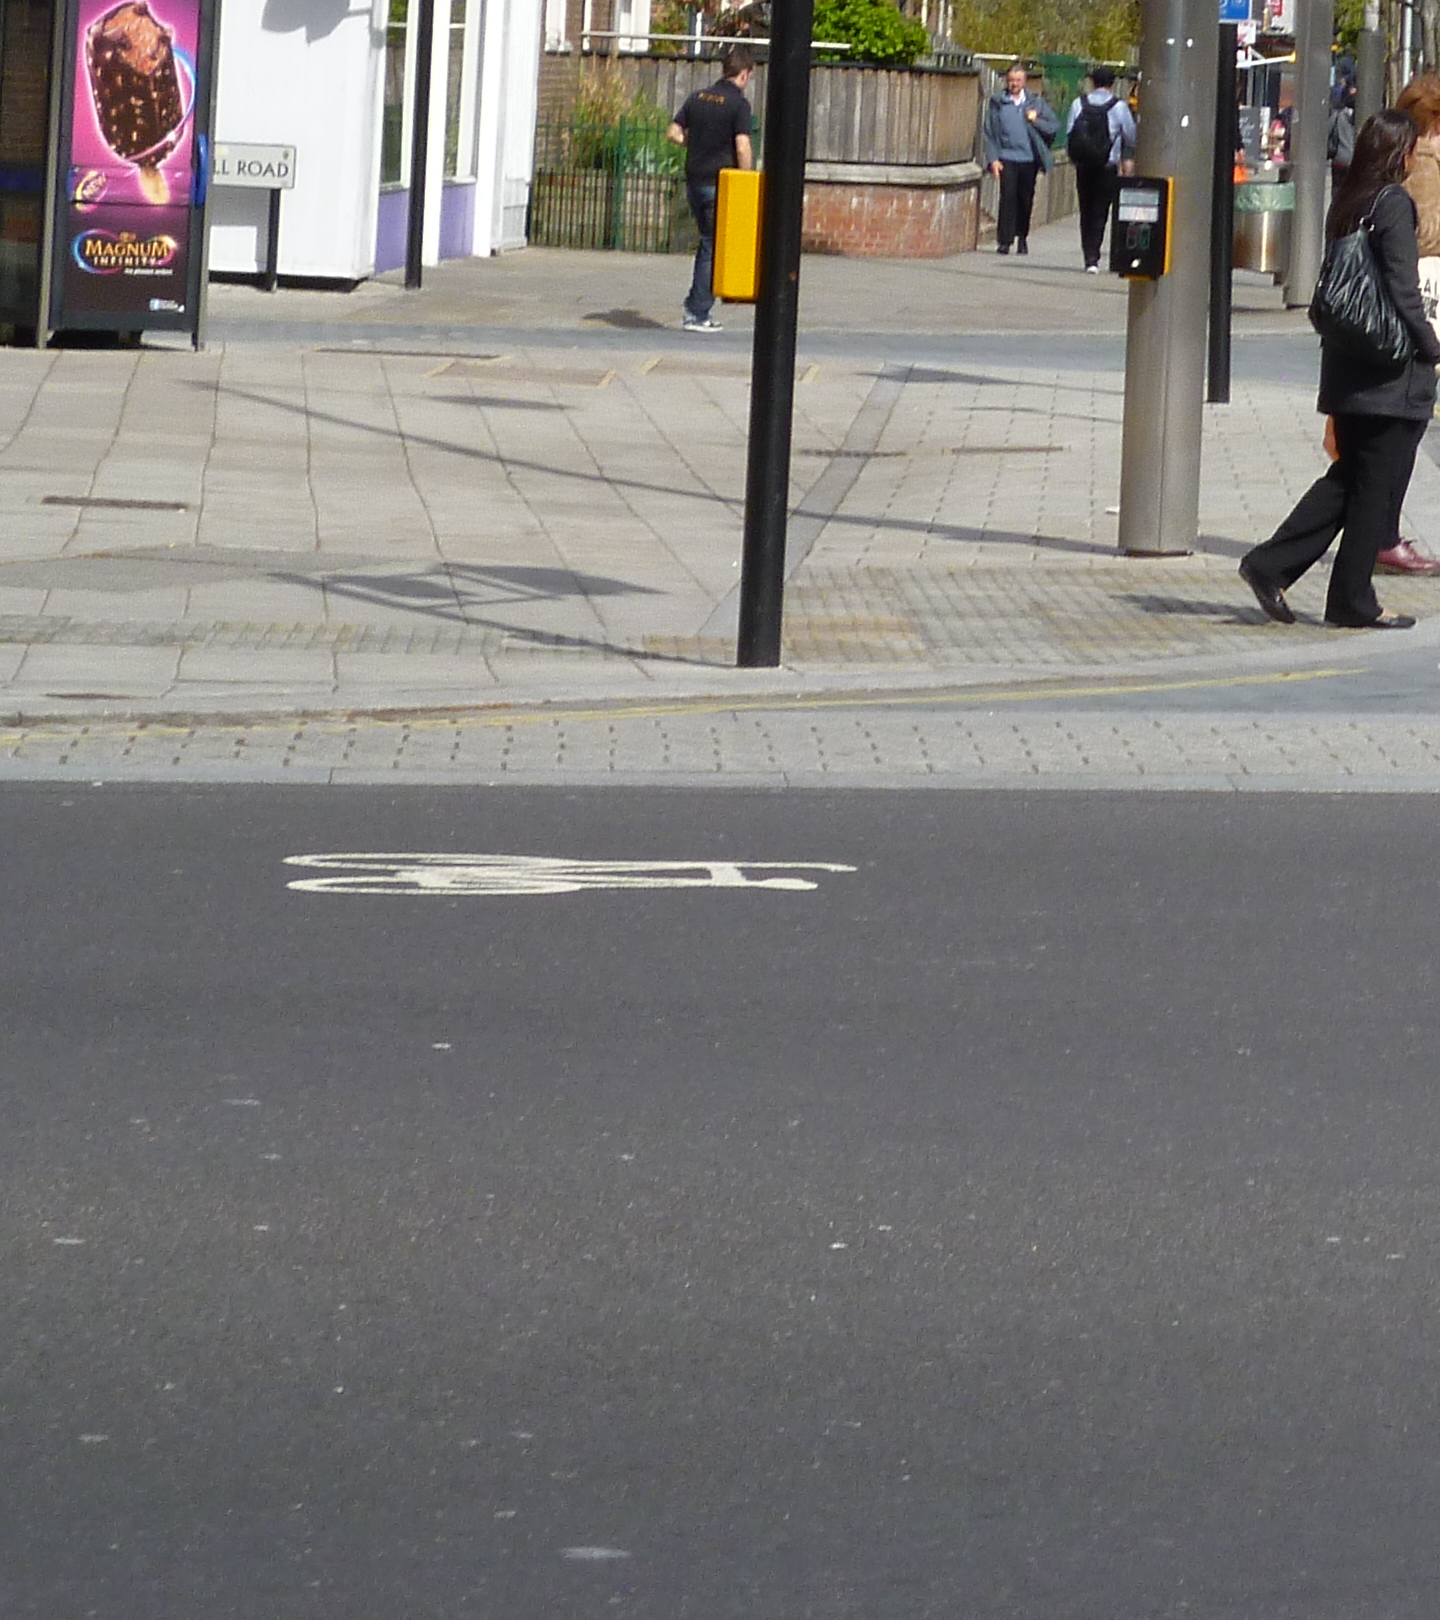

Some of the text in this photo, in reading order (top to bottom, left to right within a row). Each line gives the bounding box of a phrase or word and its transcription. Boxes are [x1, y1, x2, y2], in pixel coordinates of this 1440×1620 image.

[237, 160, 289, 178] ROAD
[85, 238, 169, 257] MAGNUM
[93, 256, 157, 266] INFINITY
